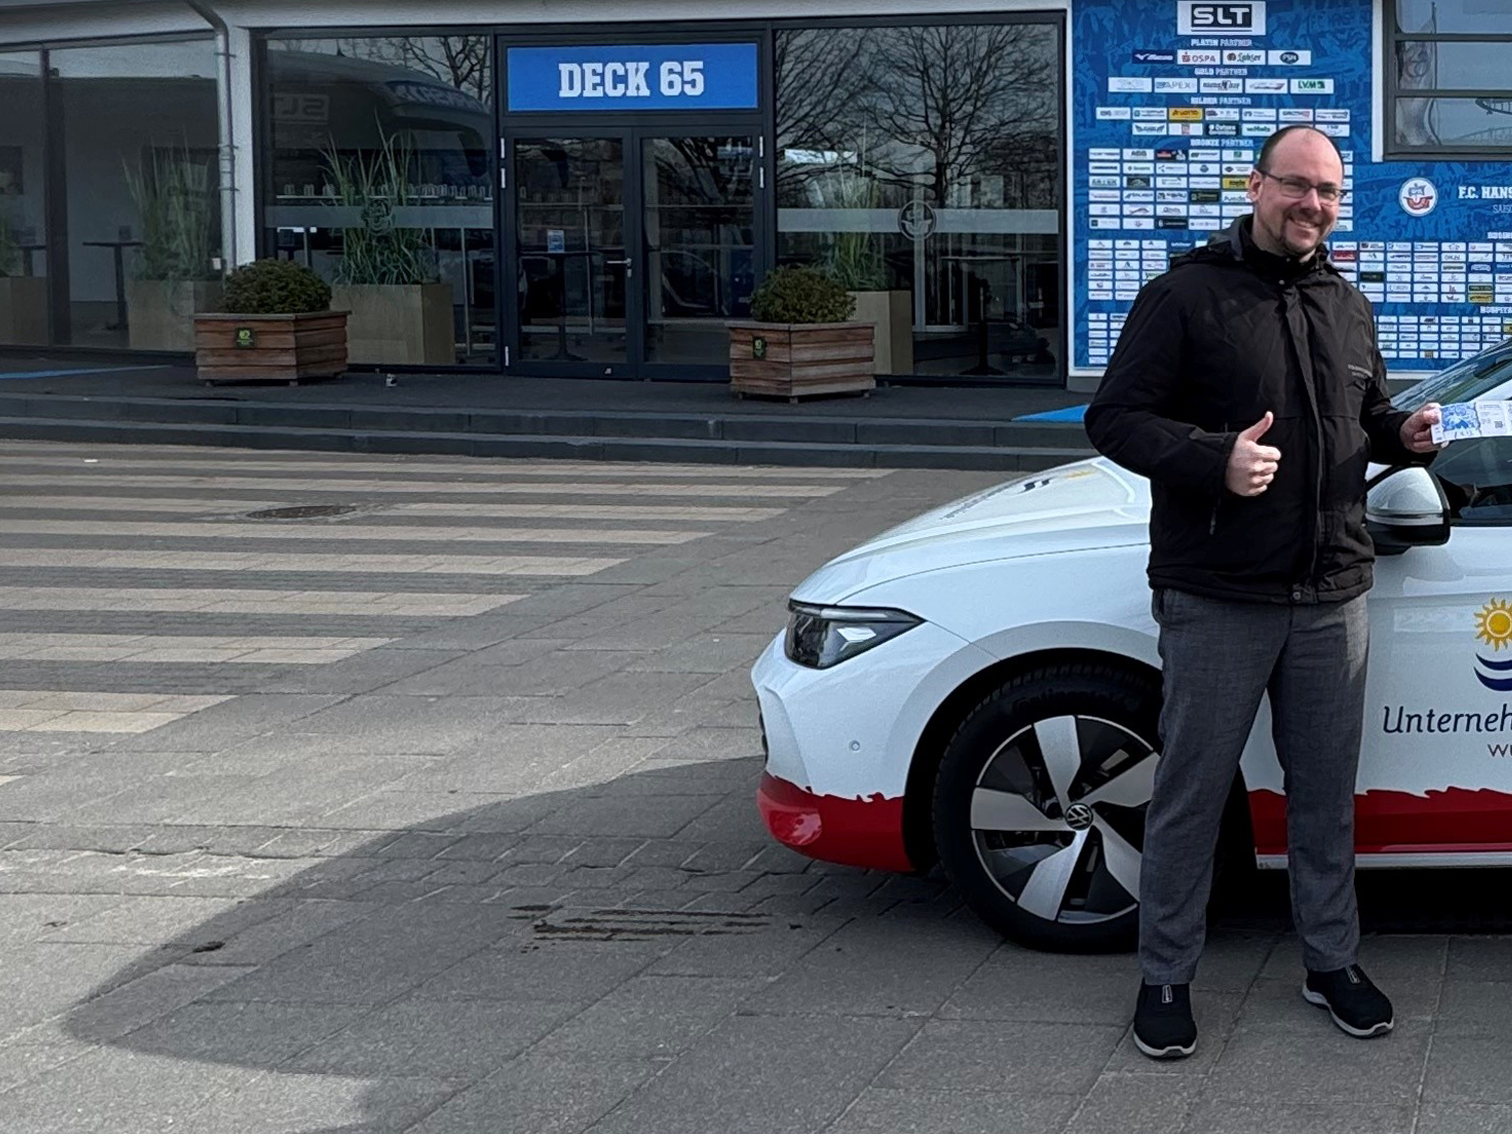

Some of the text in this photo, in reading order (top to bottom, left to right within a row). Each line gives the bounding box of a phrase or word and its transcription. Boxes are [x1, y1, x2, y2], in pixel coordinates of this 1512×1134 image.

[1193, 7, 1250, 25] SLT
[1192, 54, 1216, 63] OSPA
[559, 60, 704, 98] DECK 65
[1298, 80, 1317, 90] LVM
[1458, 186, 1479, 200] F.C.
